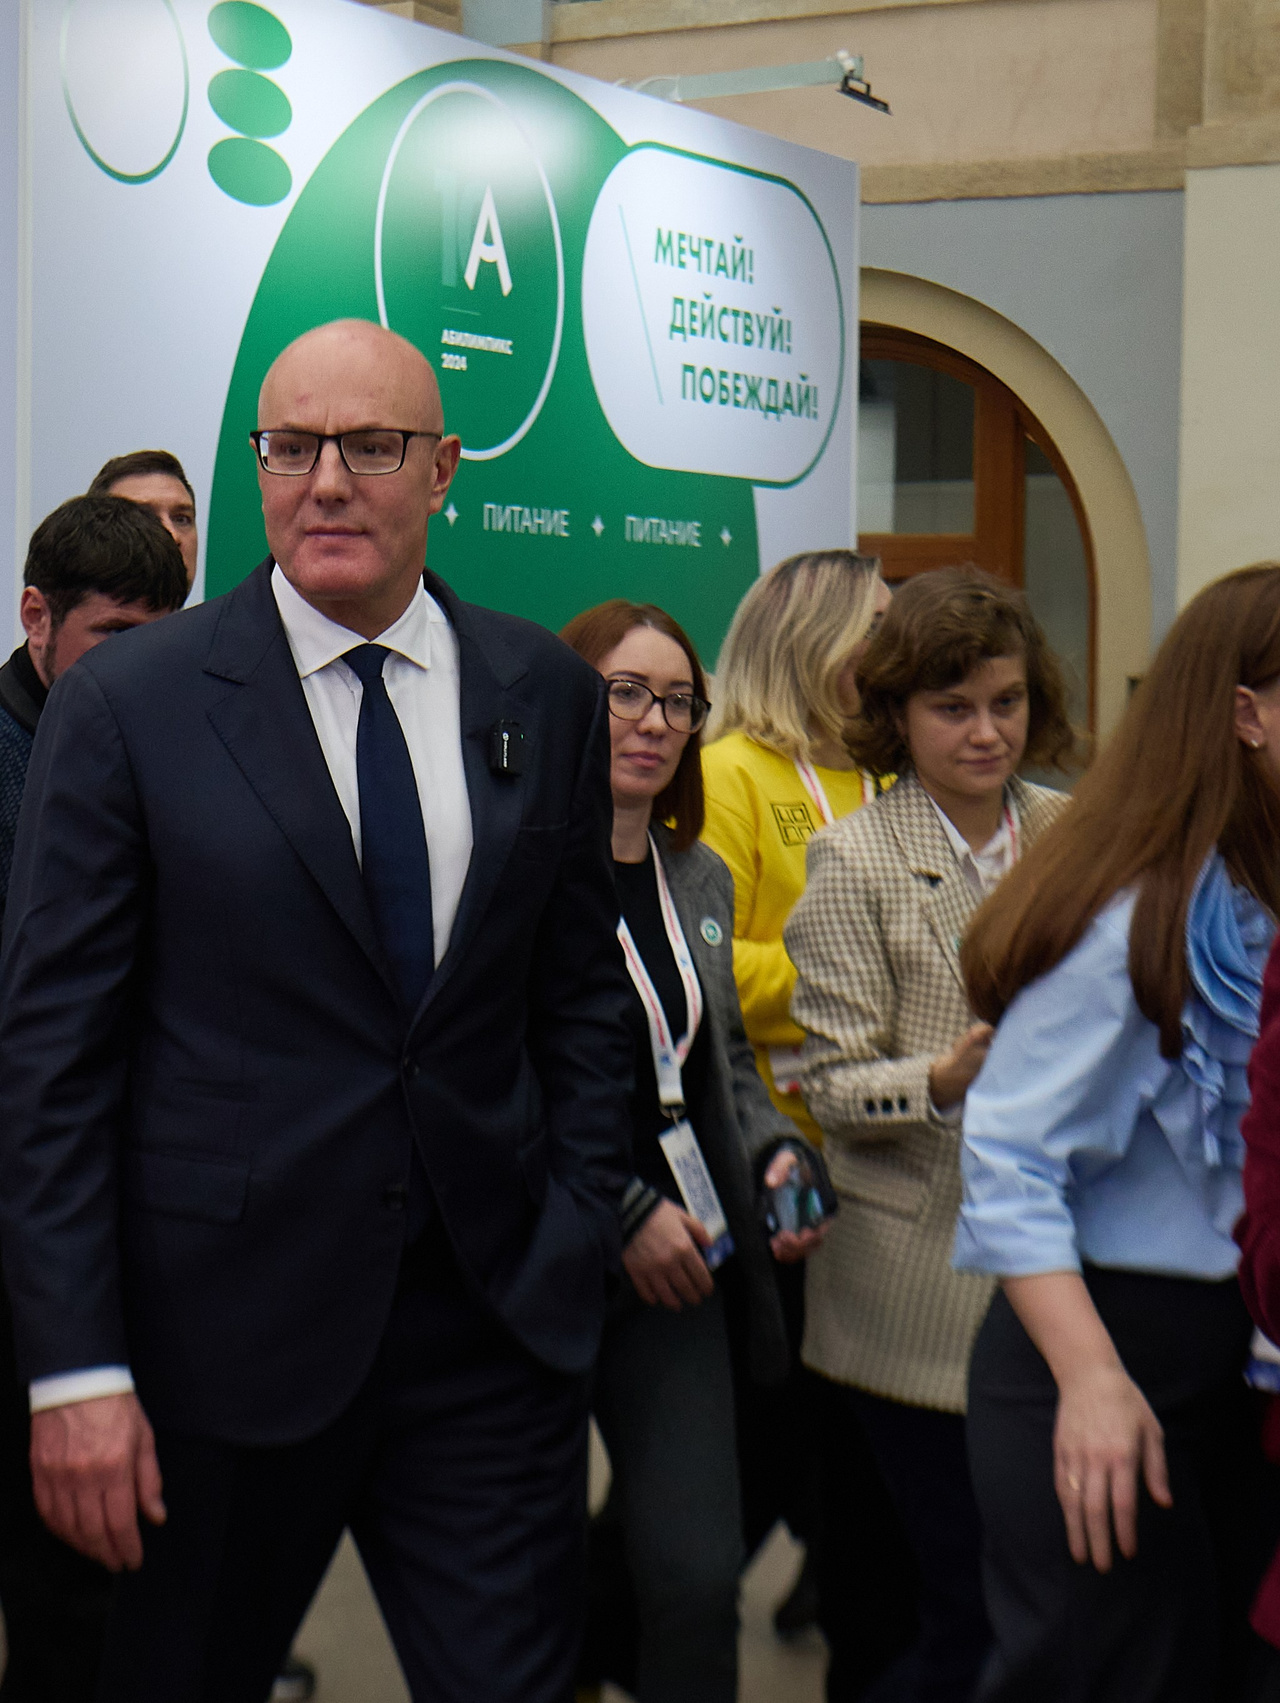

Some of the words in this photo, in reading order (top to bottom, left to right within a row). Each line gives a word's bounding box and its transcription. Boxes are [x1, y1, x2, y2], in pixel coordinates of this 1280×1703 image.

[654, 227, 755, 285] МЕЧТАЙ!
[669, 291, 792, 355] ДЕЙСТВУЙ!
[681, 363, 819, 422] ПОБЕЖДАЙ!
[483, 502, 570, 537] ПИТАНИЕ
[624, 514, 702, 547] ПИТАНИЕ
